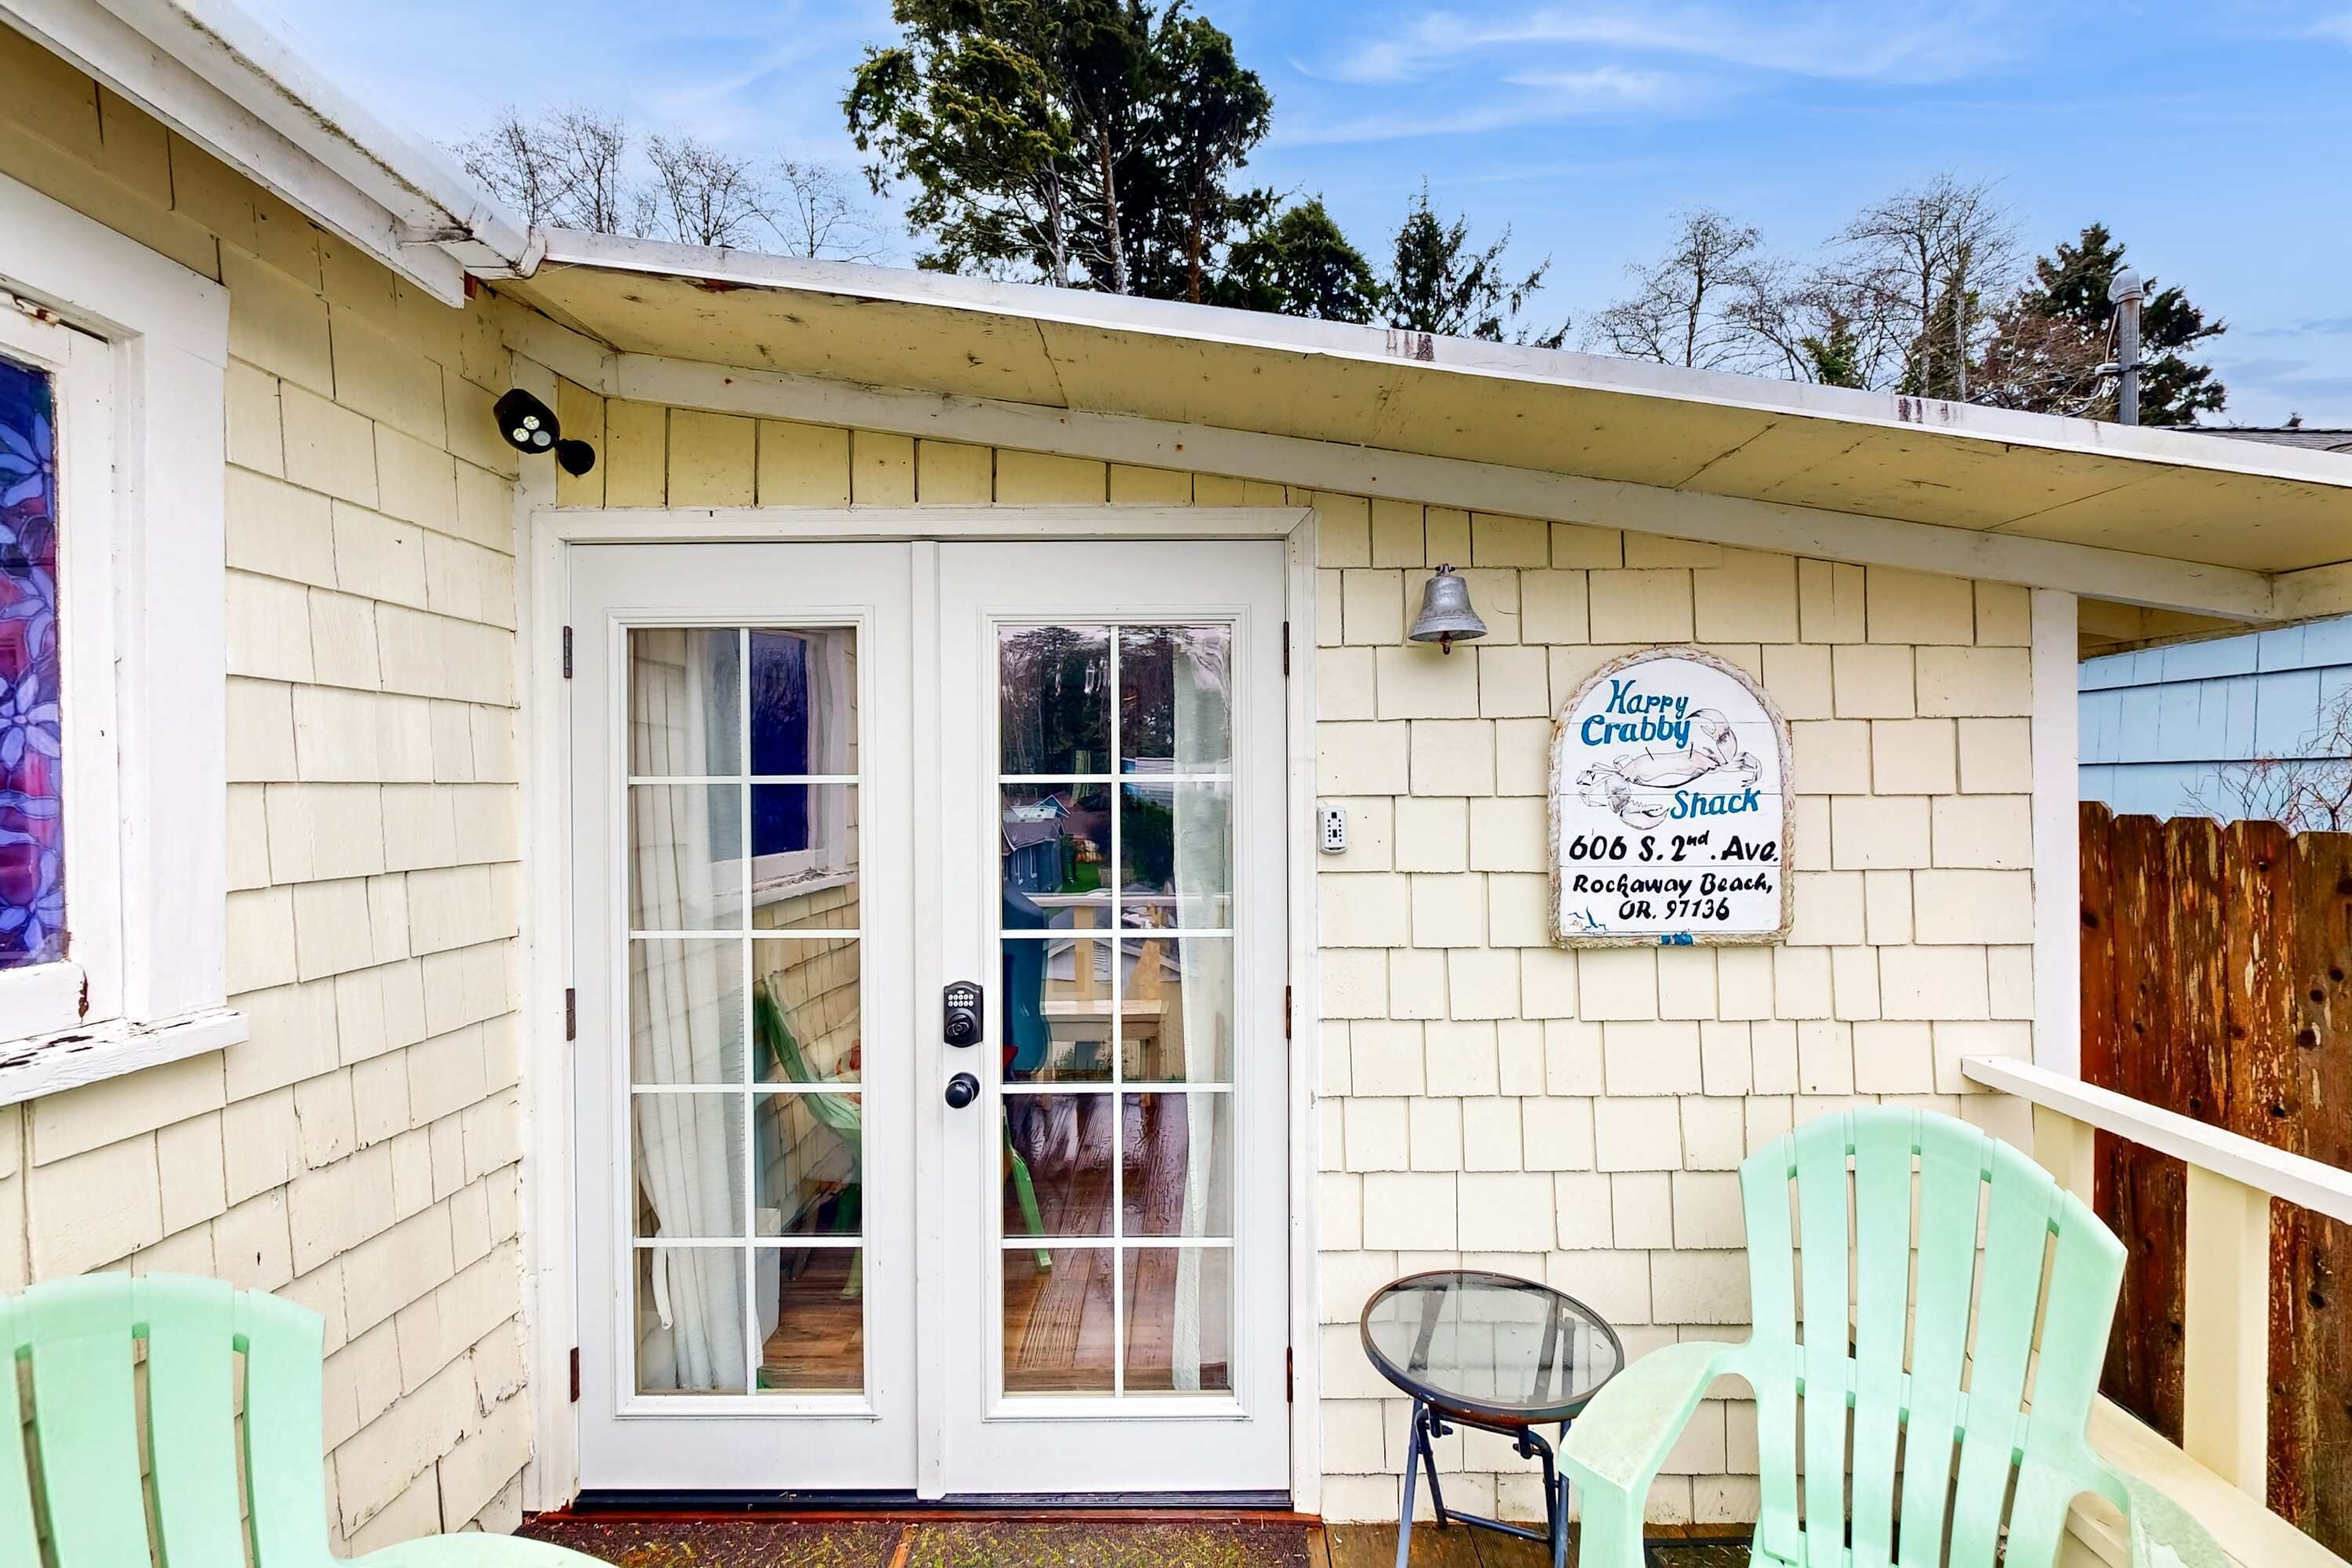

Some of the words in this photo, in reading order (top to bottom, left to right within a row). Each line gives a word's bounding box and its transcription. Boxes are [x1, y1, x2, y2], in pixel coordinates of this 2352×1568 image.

[1605, 679, 1689, 719] Happy
[1581, 714, 1691, 749] Crabby
[1670, 787, 1761, 820] Shack
[1569, 834, 1628, 862] 606
[1638, 834, 1664, 862] S.
[1719, 835, 1779, 863] Ave.
[1573, 873, 1692, 898] Rockaway
[1699, 873, 1773, 896] Beach,
[1618, 899, 1657, 920] OR.
[1664, 897, 1730, 921] 97136
